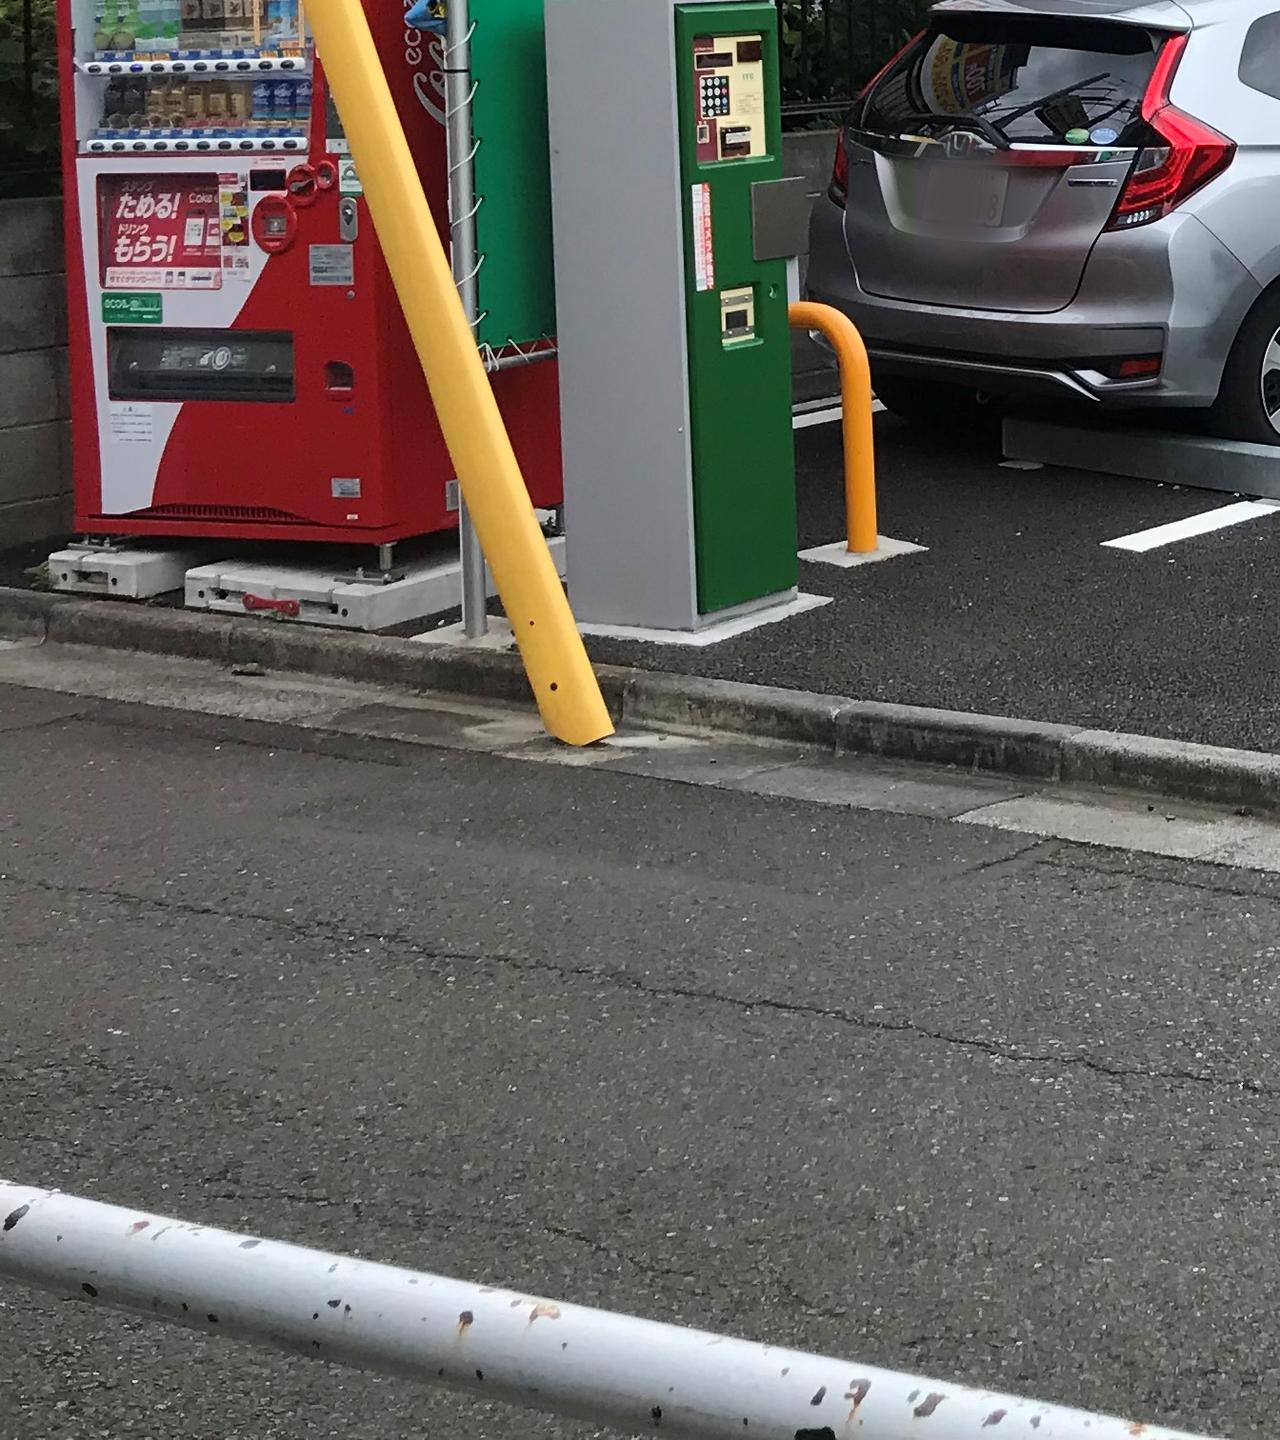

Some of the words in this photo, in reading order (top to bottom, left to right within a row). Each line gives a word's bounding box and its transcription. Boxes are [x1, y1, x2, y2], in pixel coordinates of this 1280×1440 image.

[115, 192, 182, 219] ためる!
[117, 223, 149, 235] ドリンク
[114, 235, 178, 263] もらう!
